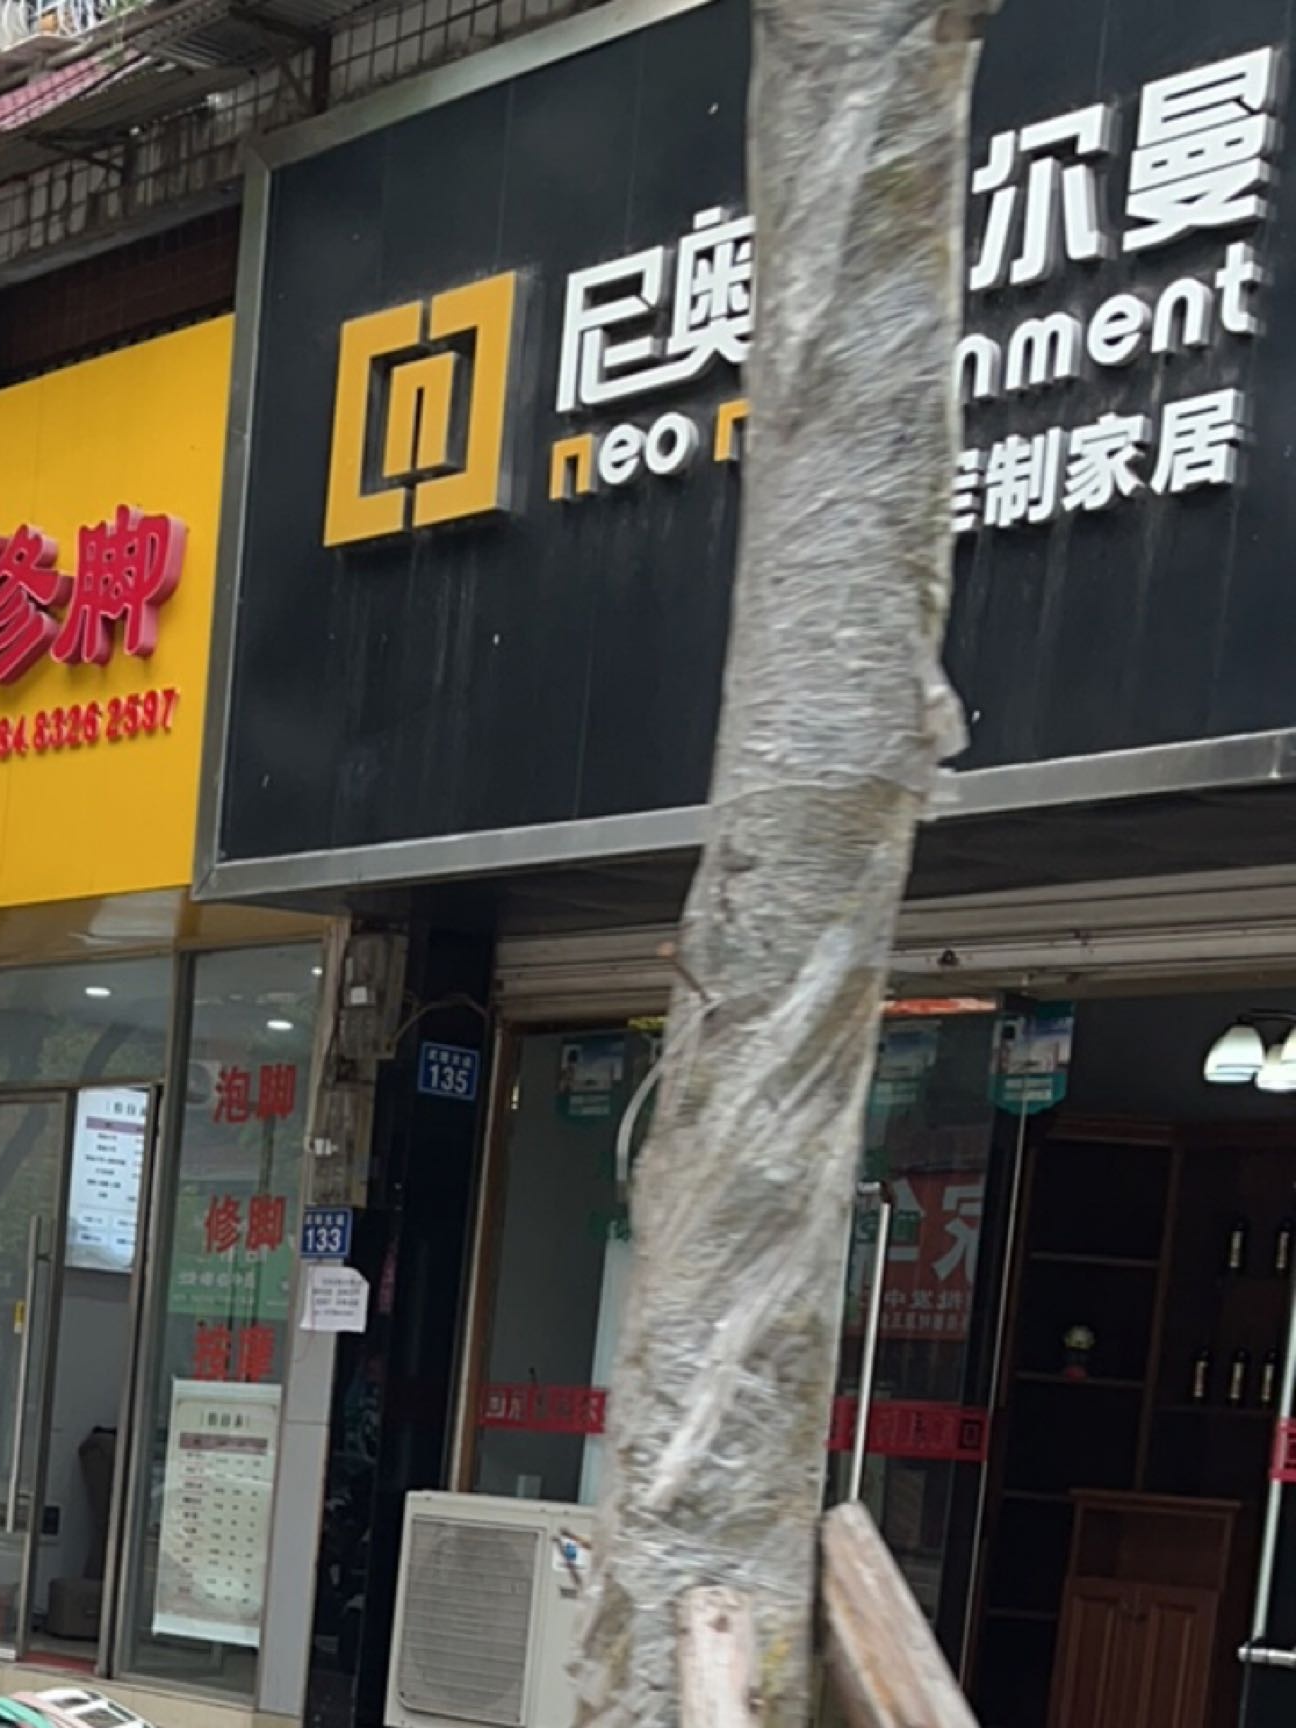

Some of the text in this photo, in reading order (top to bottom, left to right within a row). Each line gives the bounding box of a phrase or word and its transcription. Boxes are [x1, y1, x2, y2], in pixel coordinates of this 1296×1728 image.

[549, 411, 698, 499] neo
[430, 1064, 469, 1094] 135
[307, 1228, 341, 1252] 133
